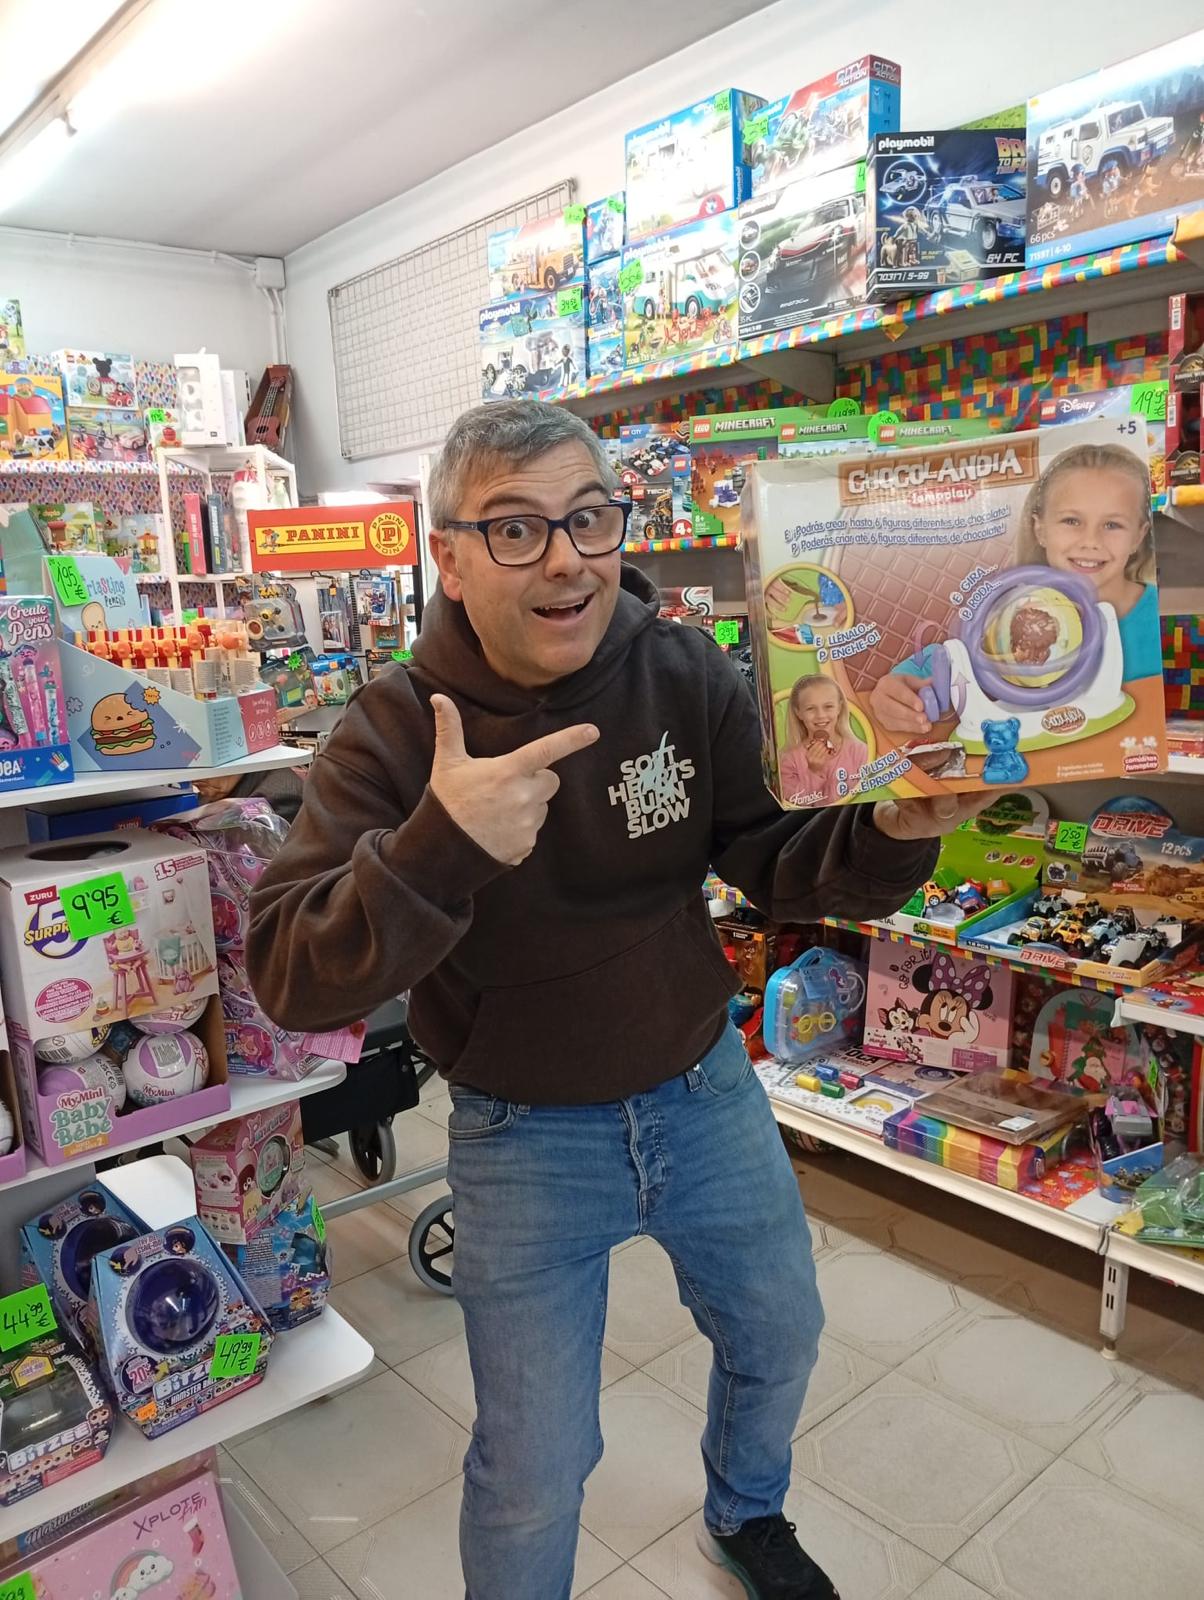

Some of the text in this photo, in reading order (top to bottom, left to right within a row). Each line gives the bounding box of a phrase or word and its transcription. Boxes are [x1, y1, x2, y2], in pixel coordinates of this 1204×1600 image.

[836, 60, 864, 81] CITY
[873, 61, 897, 73] CITY
[878, 136, 935, 152] playmobil
[1030, 232, 1041, 244] 66
[877, 272, 902, 281] 70317
[694, 417, 776, 433] LEGO MINECRAFT
[799, 423, 848, 435] MINECRAFT
[1117, 420, 1137, 435] +5
[372, 514, 405, 530] PANINI
[850, 517, 873, 527] hasta
[875, 517, 881, 527] 6
[883, 517, 910, 530] figuras
[912, 518, 952, 528] diferentes
[954, 517, 965, 526] de
[286, 526, 360, 542] PANINI
[382, 527, 396, 542] P
[835, 534, 854, 544] criar
[870, 533, 877, 543] 6
[878, 532, 906, 547] figuras
[907, 533, 948, 543] diferentes
[950, 533, 961, 542] de
[374, 543, 405, 555] POINT
[75, 585, 87, 600] €
[8, 605, 48, 621] Create
[29, 615, 48, 627] your
[8, 620, 53, 646] Pens
[832, 631, 880, 660] ENCHE-O!
[870, 751, 898, 773] LISTO!
[869, 759, 912, 789] PRONTO
[625, 780, 687, 821] BURN
[627, 797, 691, 840] SLOW
[1091, 814, 1170, 838] DRIVE
[1161, 841, 1193, 857] 12 PCS
[154, 858, 177, 881] 15
[29, 891, 53, 901] ZURU
[71, 885, 120, 920] 9'95
[107, 910, 124, 925] €
[24, 922, 70, 946] SURPR
[1020, 950, 1066, 969] DRIVE
[79, 1088, 103, 1103] Mini
[51, 1098, 111, 1129] Baby
[54, 1116, 112, 1147] Bébé
[3, 1302, 44, 1335] 44'99
[36, 1312, 51, 1328] €
[219, 1339, 254, 1370] 49'99
[238, 1355, 251, 1371] €
[170, 1384, 202, 1405] HAMSTER
[132, 1491, 202, 1540] XPLOTE
